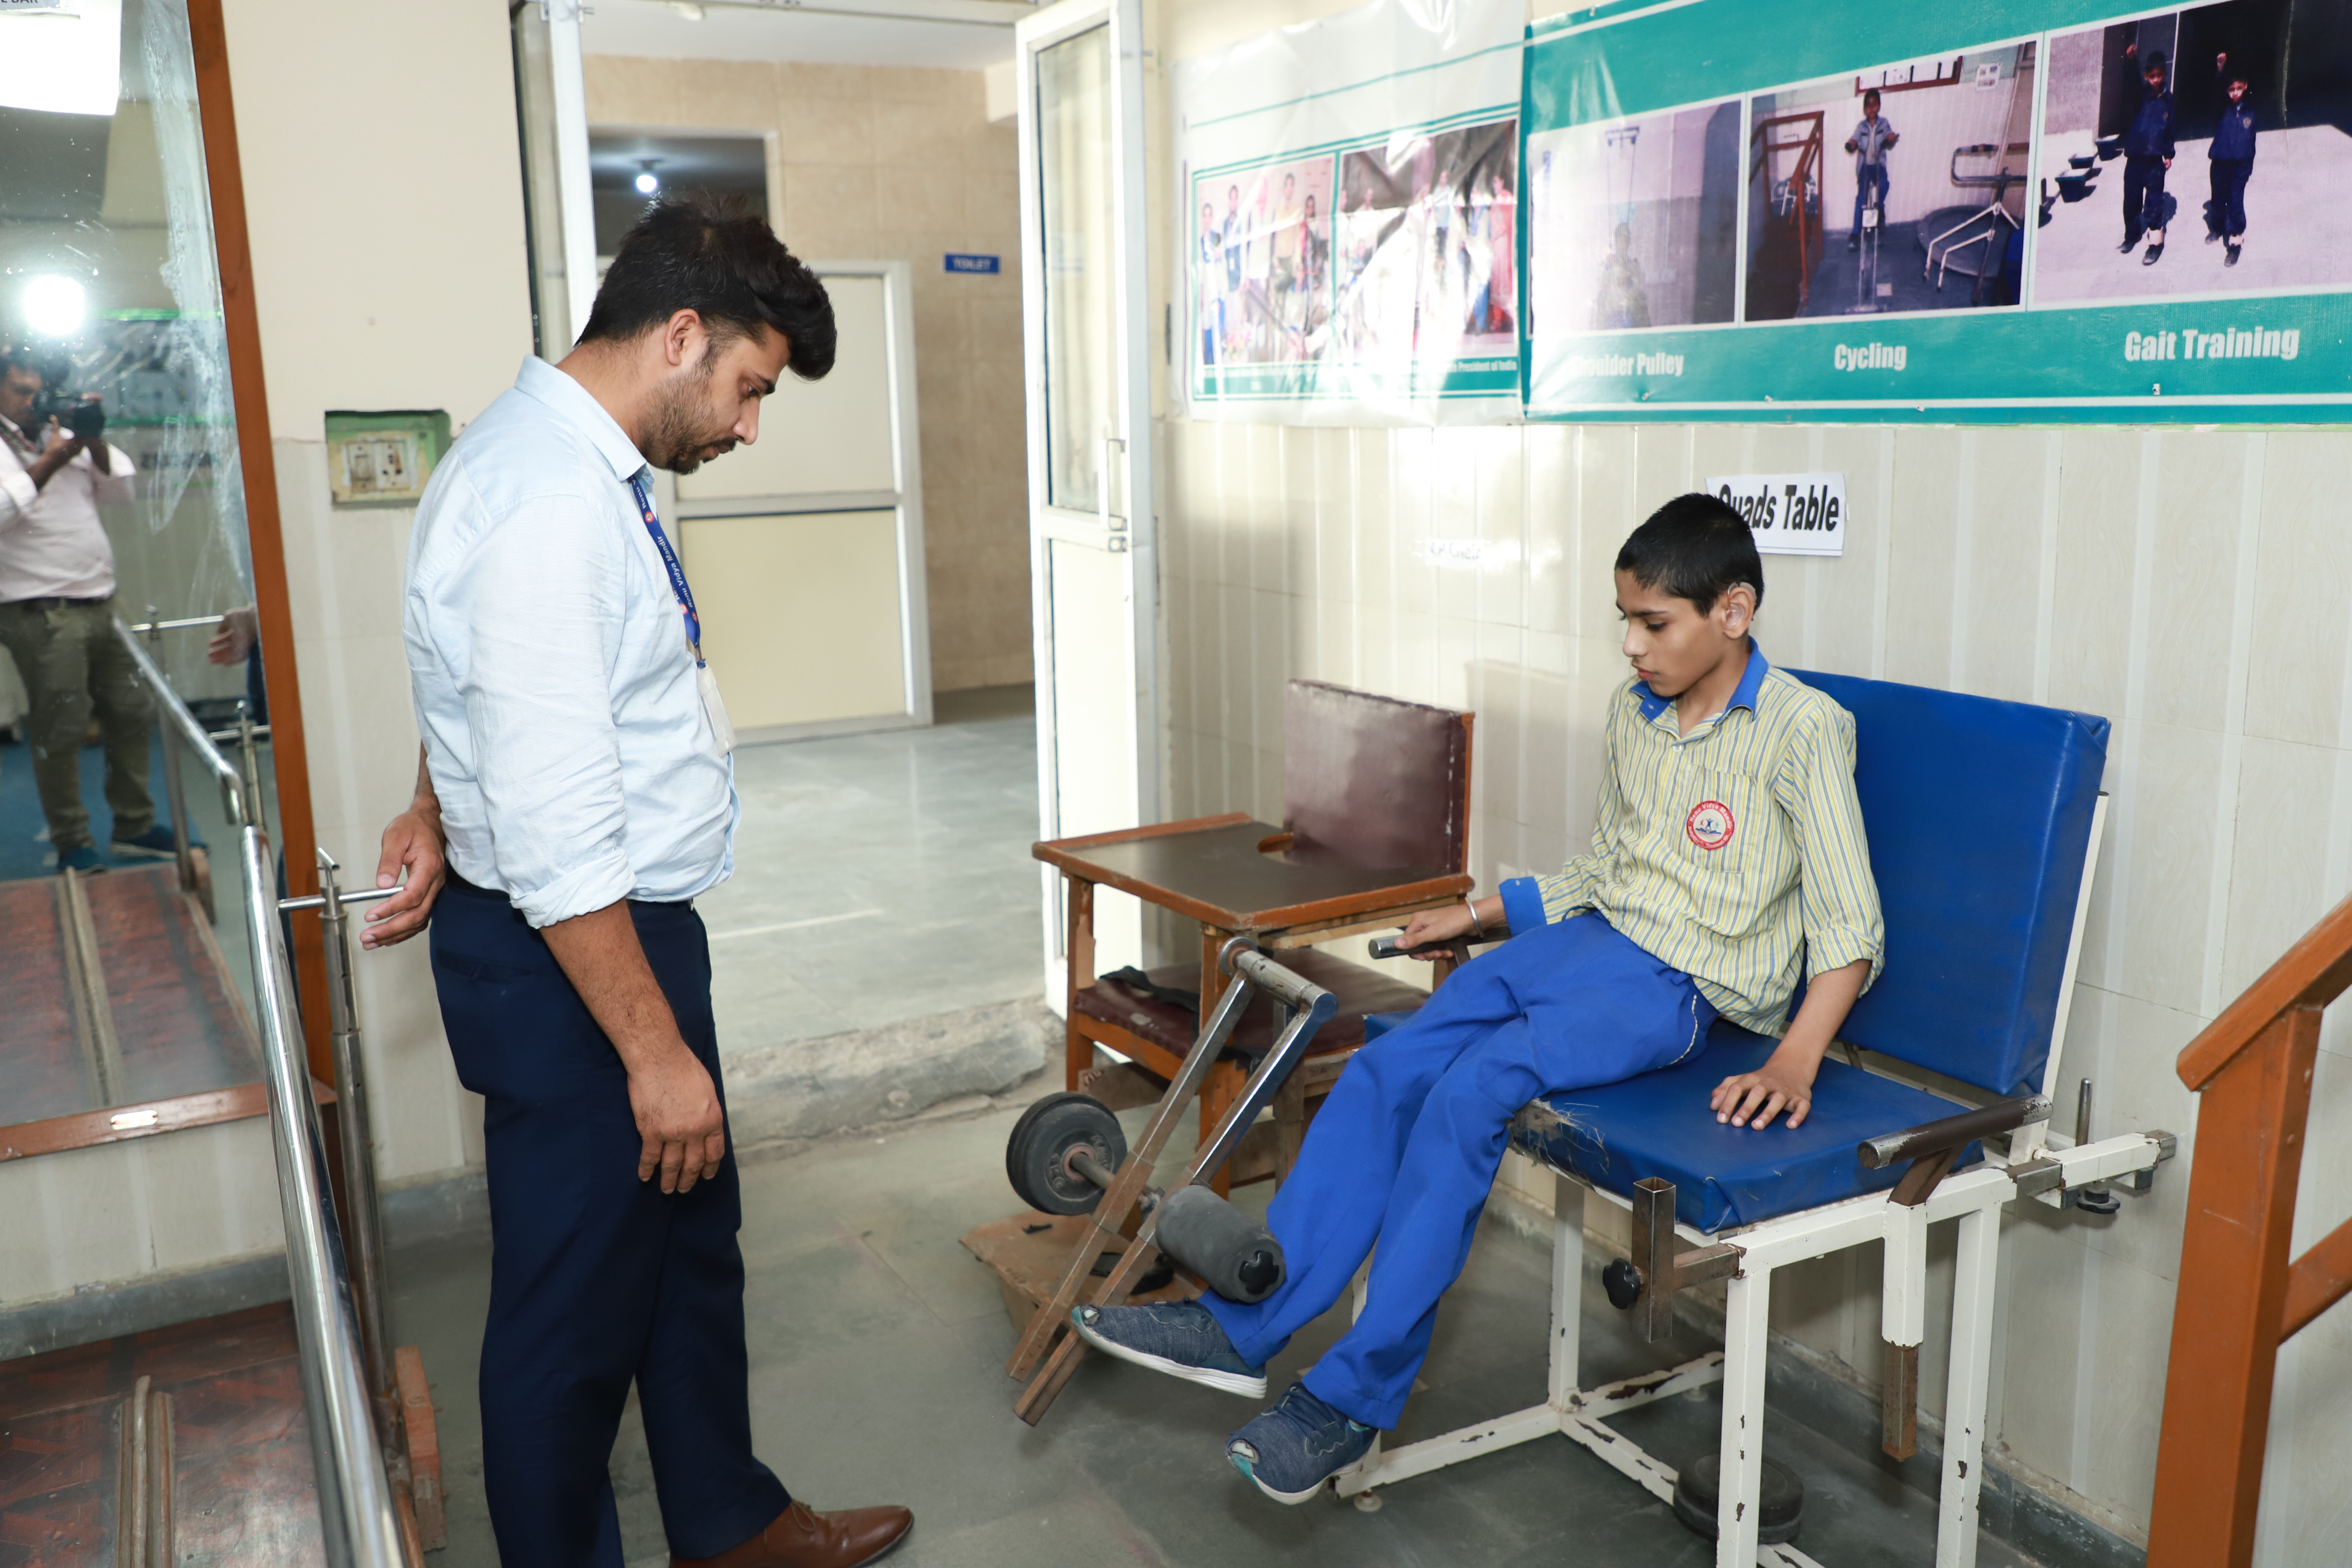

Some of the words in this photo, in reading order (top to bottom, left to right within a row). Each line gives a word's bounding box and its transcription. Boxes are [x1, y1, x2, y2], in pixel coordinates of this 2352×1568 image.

[954, 257, 991, 271] TOILET
[2125, 331, 2177, 362] Gait
[2182, 326, 2300, 360] Training
[1458, 361, 1491, 372] President
[1491, 360, 1498, 371] of
[1499, 360, 1518, 371] India
[1637, 352, 1684, 377] Pulley
[1834, 342, 1907, 372] Cycling
[636, 487, 647, 509] Renu
[1782, 484, 1839, 531] Table
[657, 536, 673, 562] Mandir
[671, 562, 683, 586] Vidya
[682, 588, 693, 608] Renu
[1689, 807, 1701, 822] Renu
[1719, 807, 1732, 829] Mandir
